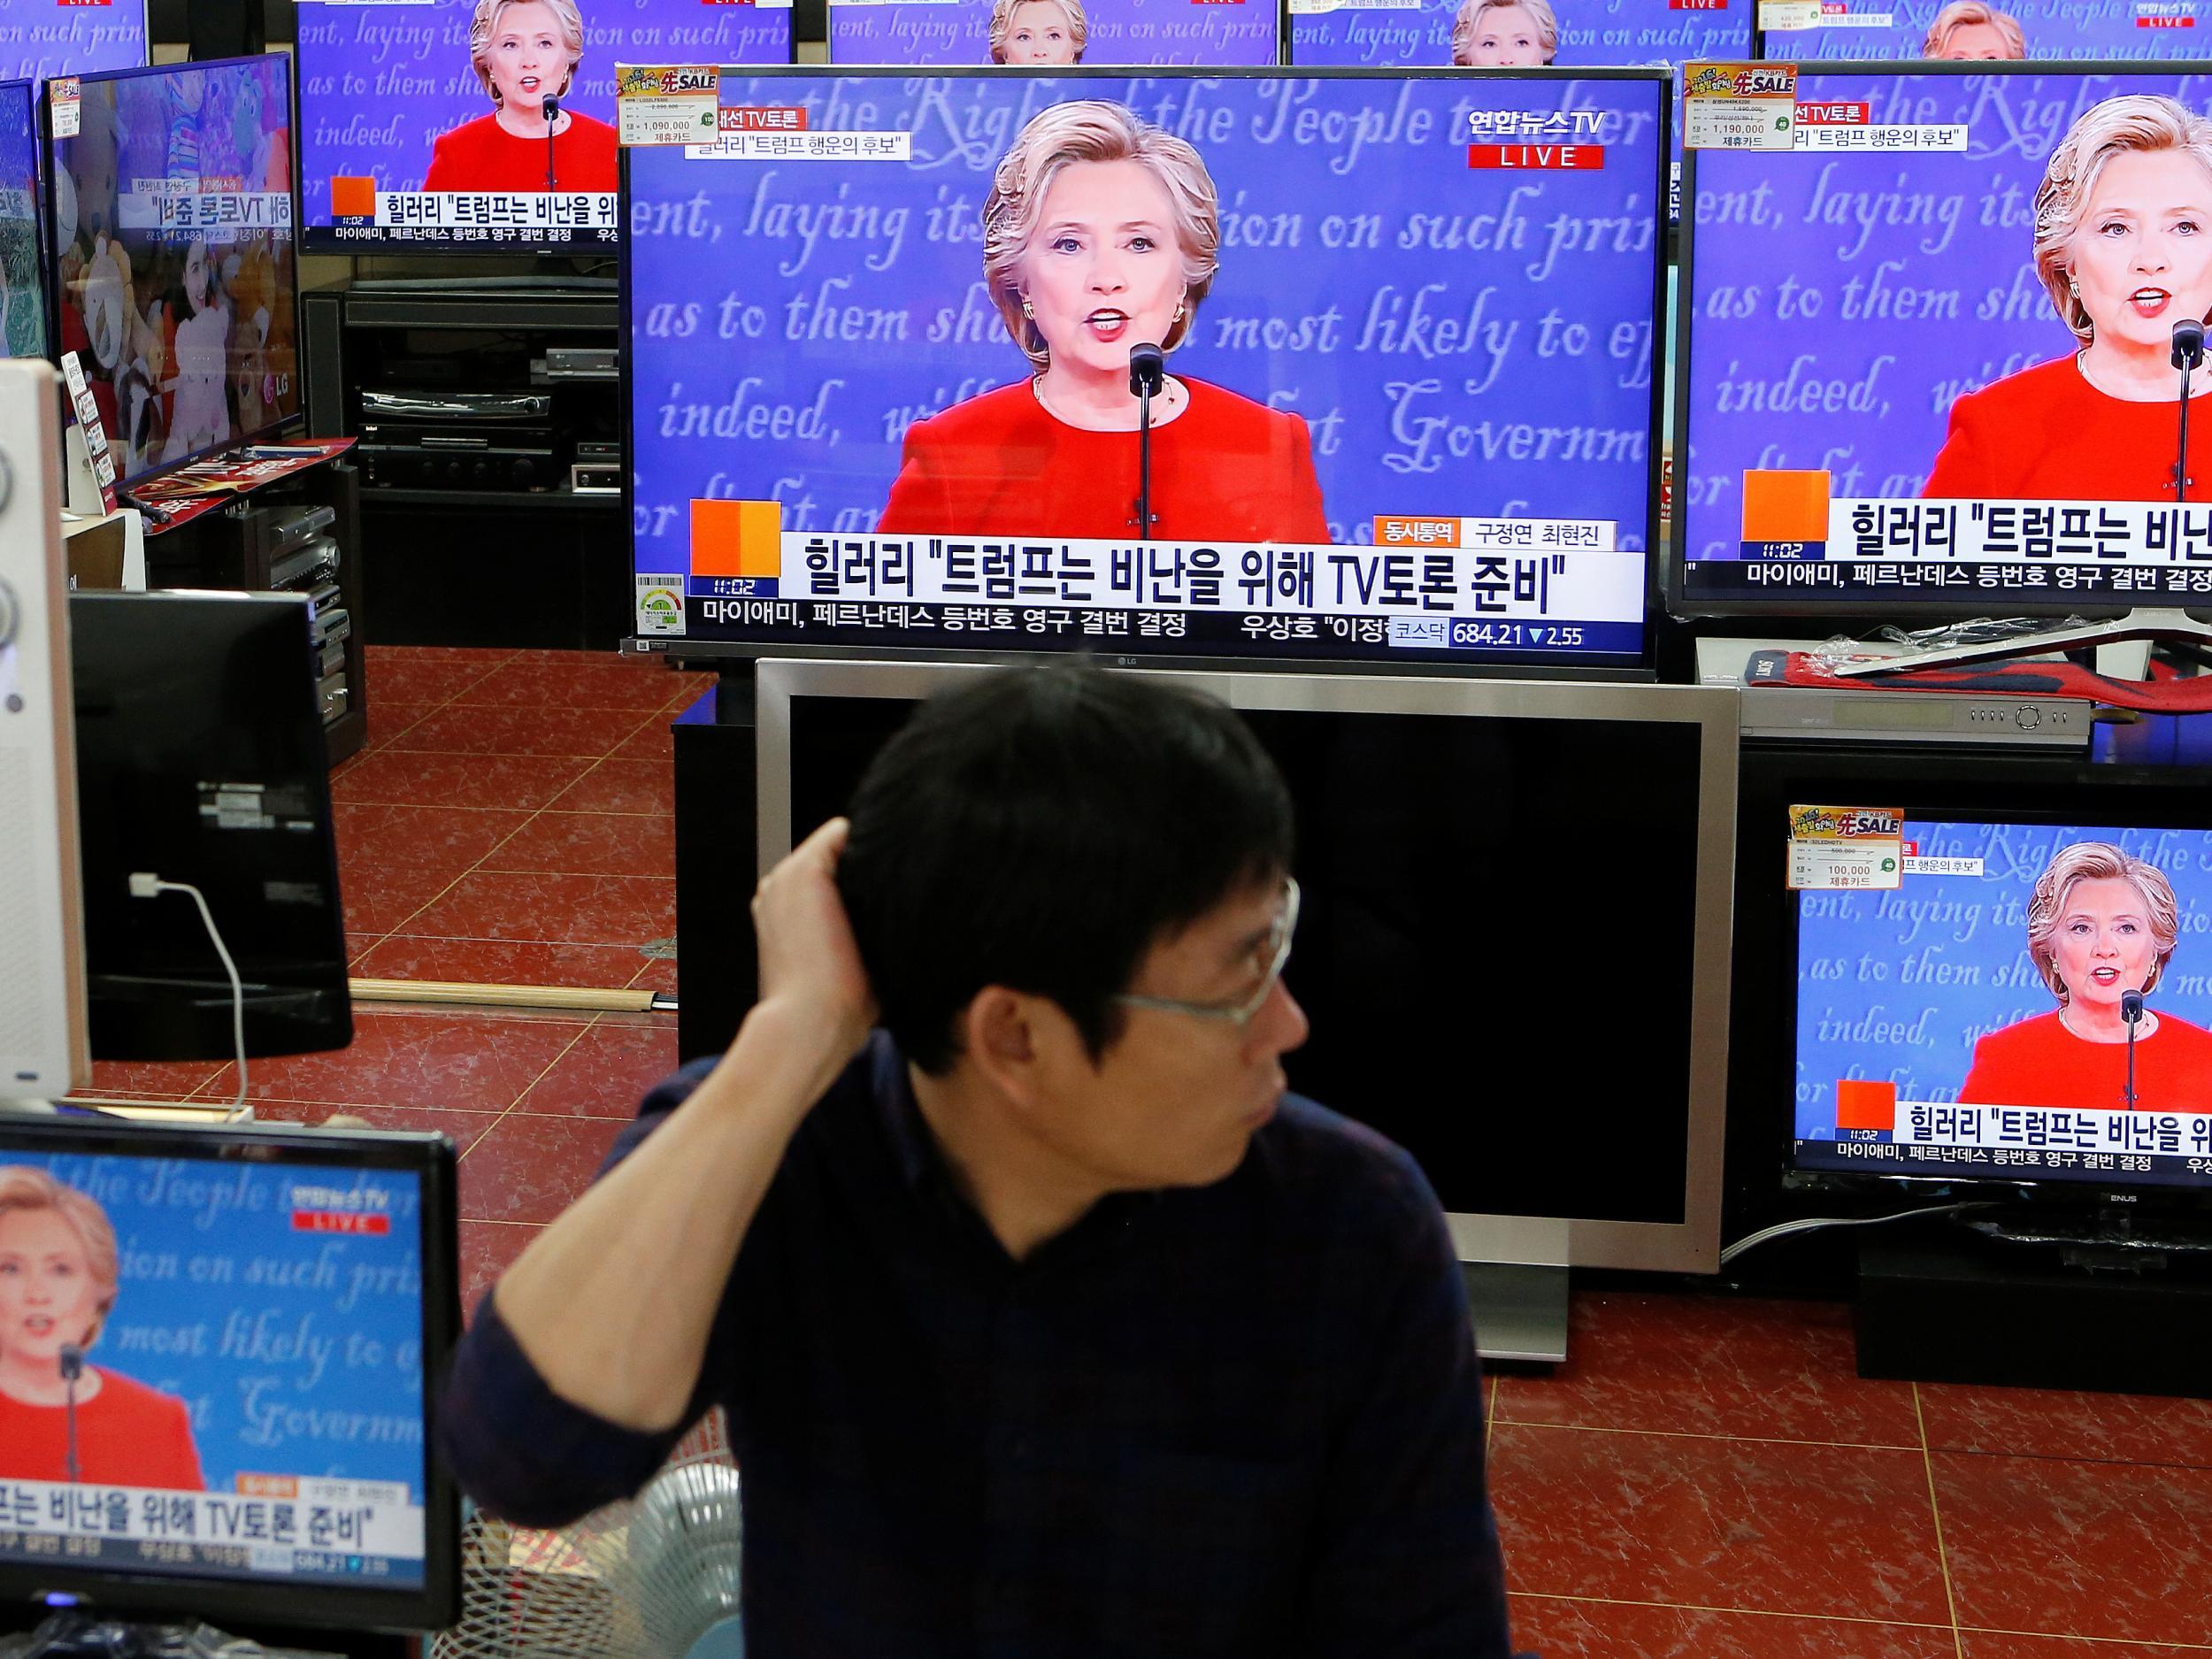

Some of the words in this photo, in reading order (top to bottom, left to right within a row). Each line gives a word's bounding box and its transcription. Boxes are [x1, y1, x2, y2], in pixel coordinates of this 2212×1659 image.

[29, 12, 87, 43] such
[355, 10, 434, 64] laying
[630, 27, 660, 45] on
[667, 11, 736, 45] such
[887, 8, 958, 53] laying
[1129, 23, 1155, 38] on
[1160, 11, 1221, 38] such
[1345, 13, 1420, 60] laying
[1602, 28, 1630, 45] on
[1637, 14, 1702, 46] such
[2148, 18, 2183, 27] LIVE
[307, 75, 334, 96] as
[342, 71, 366, 96] to
[374, 62, 436, 96] them
[644, 121, 690, 132] 1,090,000
[1468, 110, 1607, 135] 연합뉴스TV
[1810, 105, 1861, 122] TV토론
[314, 113, 404, 149] indeed,
[655, 133, 691, 142] 제휴카드
[1713, 124, 1764, 134] 1,190,000
[1722, 136, 1763, 147] 제휴카드
[1813, 129, 1867, 146] "트럼프
[1870, 129, 1918, 147] 행운의
[1922, 129, 1960, 147] 후보"
[749, 135, 805, 155] "트럼프
[809, 135, 858, 156] 행운의
[861, 135, 902, 155] 후보"
[1500, 146, 1577, 167] LIVE
[342, 216, 365, 226] 11:02
[388, 195, 441, 224] 힐러리
[448, 194, 528, 224] "트럼프는
[536, 196, 590, 225] 비난을
[597, 196, 618, 225] 위
[742, 171, 910, 277] laying
[1319, 210, 1382, 250] on
[1396, 182, 1545, 251] such
[1803, 161, 1963, 262] laying
[335, 227, 387, 242] 마이애미,
[389, 227, 449, 242] 페르난데스
[452, 228, 489, 242] 등번호
[492, 229, 517, 242] 영구
[519, 229, 544, 242] 결번
[547, 229, 572, 242] 결정
[1707, 286, 1762, 319] as
[1776, 273, 1824, 319] to
[1841, 259, 1959, 321] them
[645, 302, 701, 338] as
[718, 290, 766, 341] to
[784, 274, 908, 342] them
[1215, 305, 1344, 354] most
[1354, 283, 1519, 396] likely
[1537, 307, 1591, 358] to
[275, 373, 288, 396] LG
[1717, 354, 1896, 419] indeed,
[659, 377, 846, 447] indeed,
[1382, 378, 1646, 474] Governm
[1383, 520, 1454, 543] 동시통역
[1474, 523, 1533, 546] 구정연
[1541, 523, 1600, 548] 최현진
[1852, 503, 1957, 557] 힐러리
[1971, 503, 2131, 559] "트럼프는
[1763, 543, 1803, 559] 11:02
[714, 579, 757, 595] 11:02
[804, 538, 914, 597] 힐러리
[929, 539, 1095, 601] "트럼프는
[1110, 547, 1225, 606] 비난을
[1238, 549, 1315, 609] 위해
[1327, 554, 1458, 611] TV토론
[1471, 554, 1565, 615] 준비"
[1747, 564, 1845, 588] 마이애미,
[1853, 565, 1970, 588] 페르난데스
[1976, 565, 2048, 588] 등번호
[2055, 567, 2103, 590] 영구
[2110, 568, 2157, 591] 결번
[2165, 569, 2212, 593] 결정
[703, 601, 804, 628] 마이애미,
[812, 603, 935, 629] 페르난데스
[941, 607, 1018, 631] 등번호
[1023, 609, 1073, 634] 영구
[1079, 611, 1129, 636] 결번
[1136, 612, 1187, 637] 결정
[1240, 615, 1318, 641] 우상호
[1394, 622, 1445, 642] 코스닥
[1453, 622, 1523, 645] 684.21
[1546, 626, 1583, 647] 2.55
[1828, 865, 1870, 875] 100,000
[1918, 858, 1950, 872] 행운의
[1829, 876, 1870, 887] 제휴카드
[1874, 889, 1983, 946] laying
[1809, 956, 1846, 981] as
[1857, 950, 1888, 982] to
[1901, 942, 1982, 987] them
[1816, 1005, 1938, 1049] indeed,
[1850, 1130, 1879, 1141] 11:02
[1910, 1105, 1982, 1144] 힐러리
[1991, 1107, 2099, 1148] "트럼프는
[2108, 1115, 2182, 1152] 비난을
[1837, 1142, 1905, 1162] 마이애미,
[1909, 1145, 1989, 1164] 페르난데스
[1992, 1149, 2041, 1166] 등번호
[2045, 1151, 2078, 1169] 영구
[2082, 1153, 2115, 1170] 결번
[2119, 1155, 2152, 1171] 결정
[311, 1215, 371, 1233] LIVE
[344, 1333, 385, 1368] to
[50, 1488, 128, 1532] 비난을
[142, 1494, 196, 1536] 위해
[204, 1501, 295, 1544] TV토론
